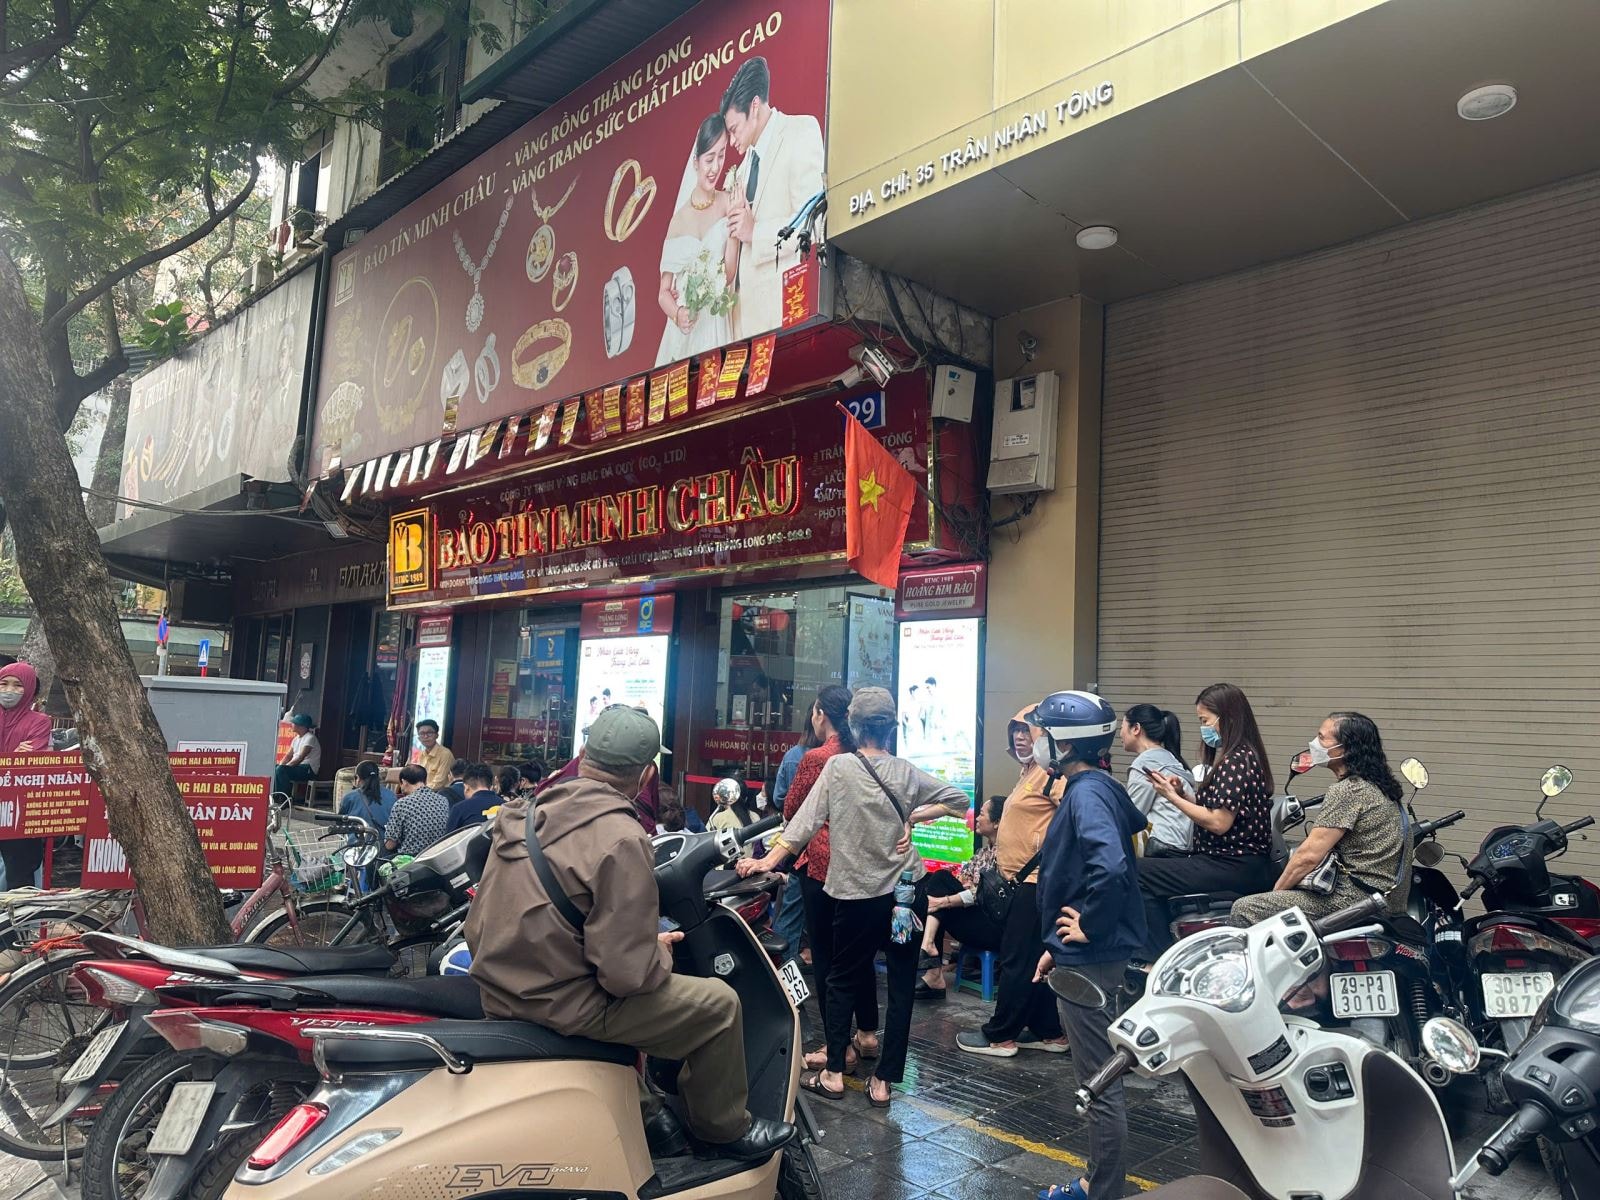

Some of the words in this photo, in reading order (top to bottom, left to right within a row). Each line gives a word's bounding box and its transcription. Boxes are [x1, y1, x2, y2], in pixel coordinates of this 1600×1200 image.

[512, 160, 546, 195] VÀNG
[548, 130, 593, 173] TRANG
[595, 110, 625, 145] SỨC
[627, 79, 670, 123] CHẤT
[672, 40, 734, 98] LƯỢNG
[738, 11, 782, 54] CAO
[515, 131, 548, 167] VÀNG
[550, 104, 590, 145] RỒNG
[592, 68, 642, 117] THĂNG
[646, 35, 692, 82] LONG
[849, 188, 876, 216] ĐỊA
[915, 158, 935, 185] 35
[940, 134, 991, 174] TRẦN
[994, 109, 1049, 150] NHÂN
[1055, 80, 1115, 124] TÔNG
[363, 244, 388, 275] BẢO
[390, 227, 412, 258] TÍN
[413, 201, 451, 244] MINH
[453, 171, 497, 217] CHÂU
[848, 397, 876, 423] 29
[437, 510, 495, 570] BẢO
[497, 500, 551, 560] TÍN
[553, 484, 661, 552] MINH
[666, 445, 800, 533] CHÂU
[935, 583, 952, 596] KIM
[14, 757, 26, 766] AN
[63, 756, 77, 764] HAI
[188, 757, 201, 765] HAI
[14, 773, 46, 789] NGHỊ
[47, 770, 82, 786] NHÂN
[193, 781, 210, 793] HAI
[230, 781, 264, 795] TRƯNG
[219, 802, 254, 821] DÂN
[1339, 975, 1385, 994] 29-P1
[1493, 975, 1544, 994] 30-F6
[1341, 993, 1387, 1013] 3010
[444, 1163, 556, 1188] EVO
